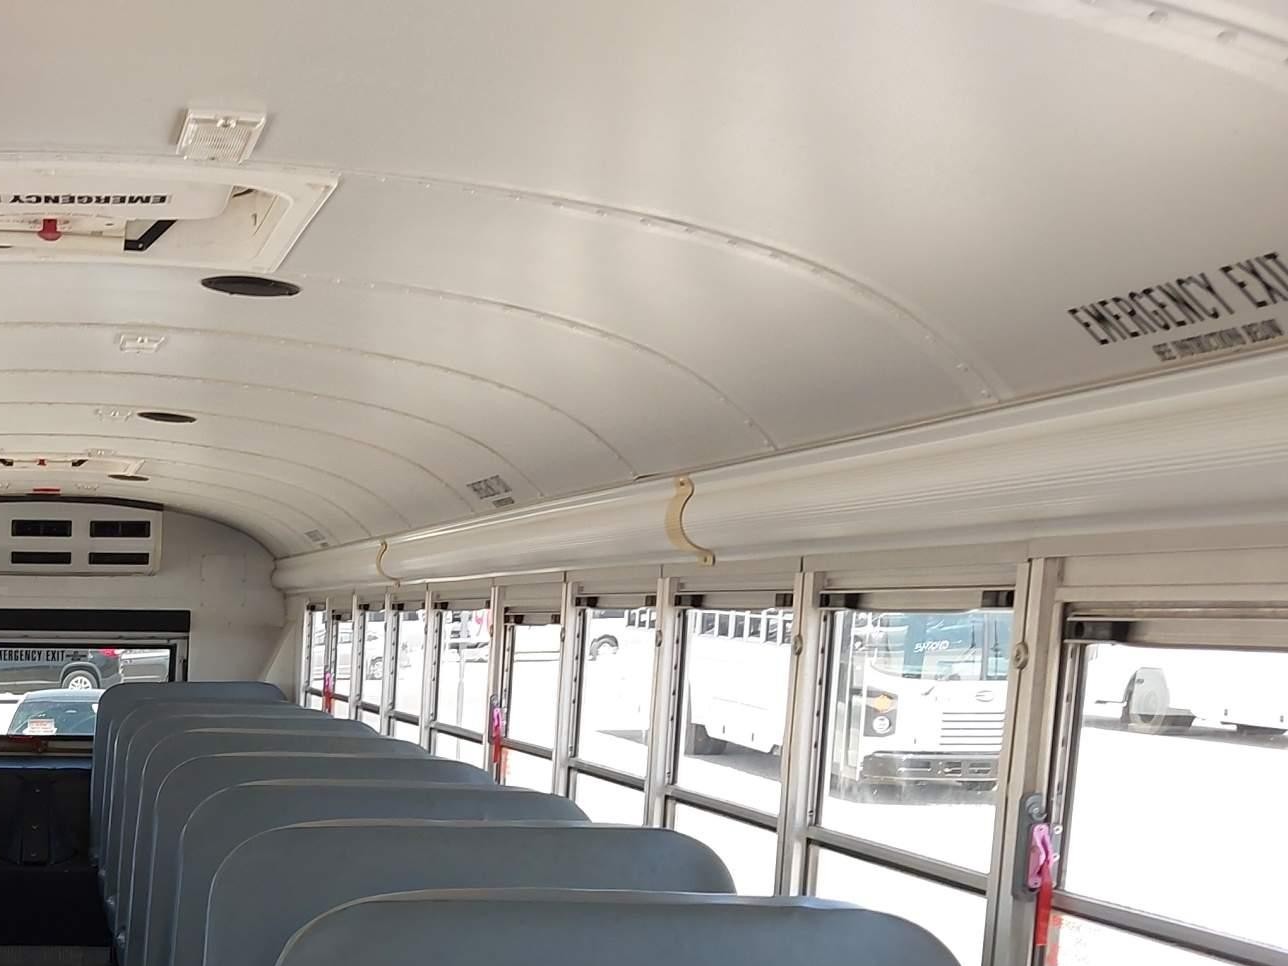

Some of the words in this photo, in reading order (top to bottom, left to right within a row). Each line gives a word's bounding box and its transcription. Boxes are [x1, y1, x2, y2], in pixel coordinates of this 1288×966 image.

[9, 194, 168, 205] EMERGENCY
[1068, 272, 1235, 345] EMERGENCY
[46, 649, 65, 662] EXIT
